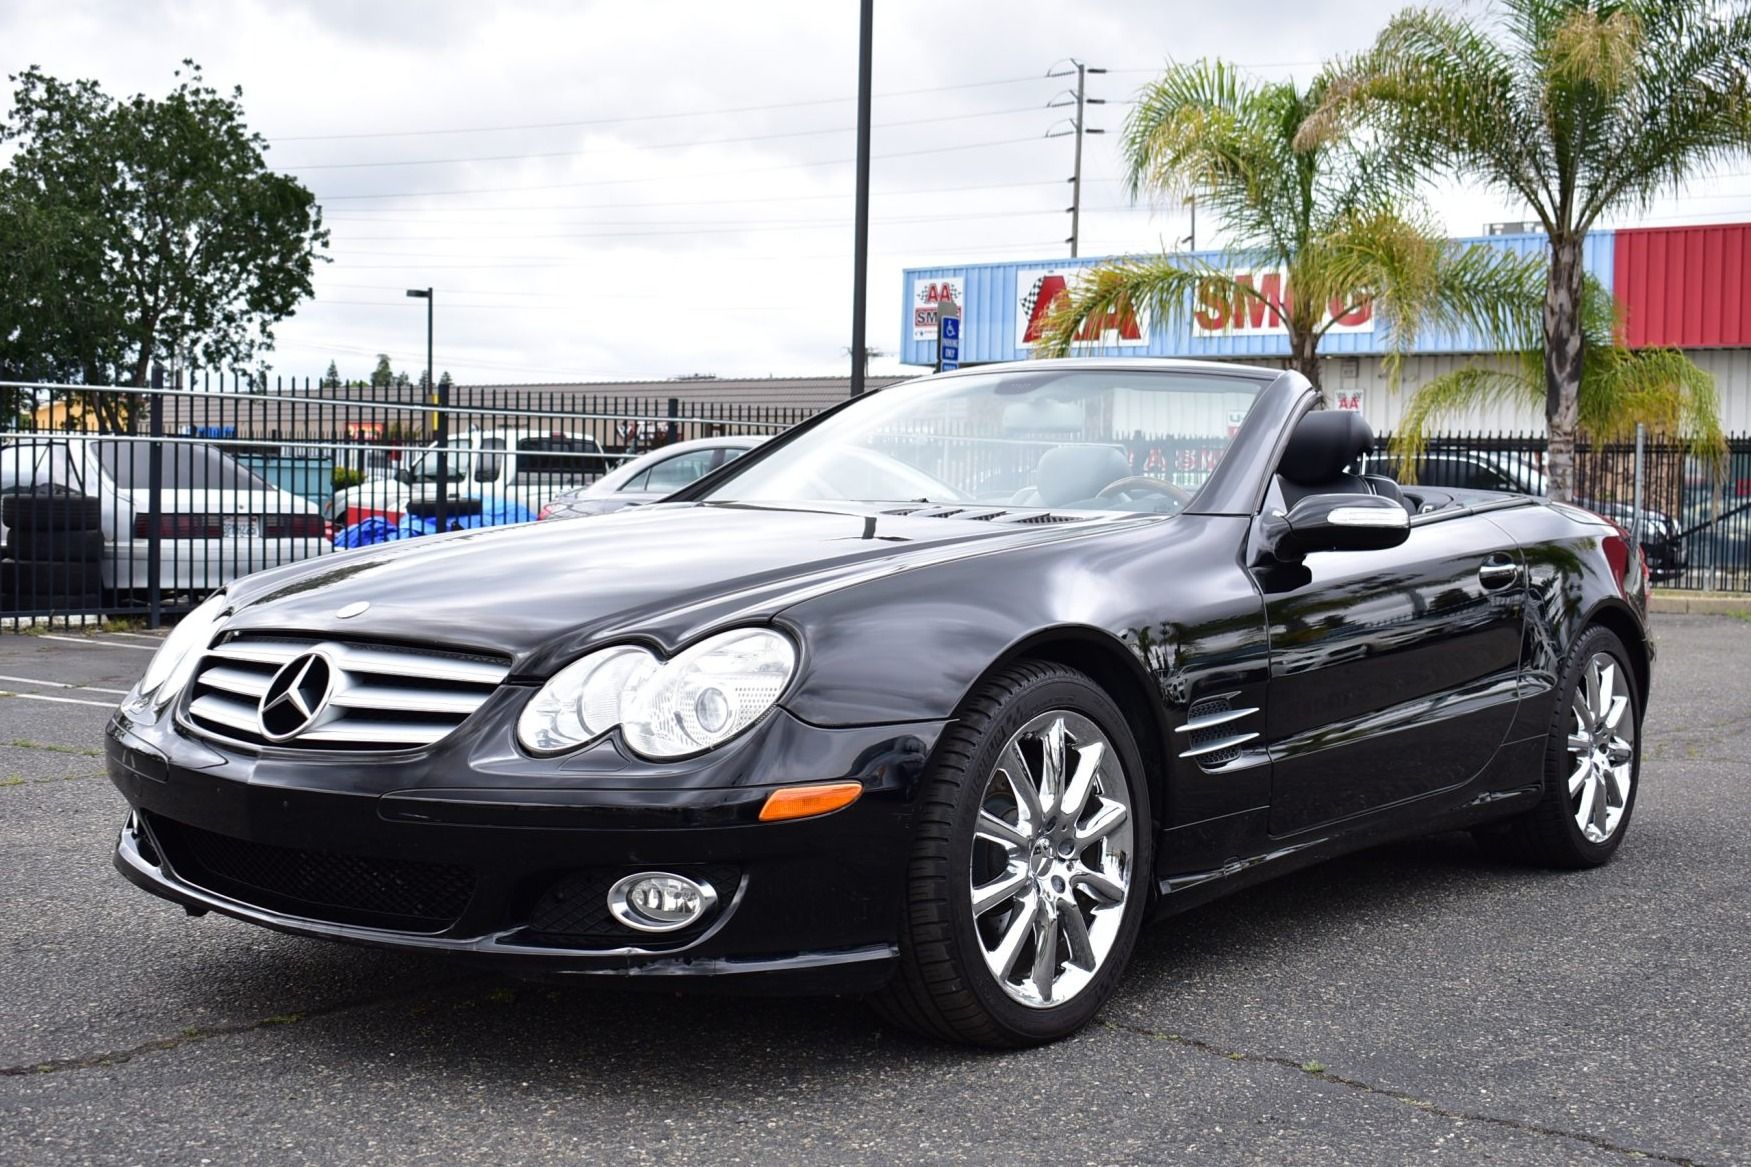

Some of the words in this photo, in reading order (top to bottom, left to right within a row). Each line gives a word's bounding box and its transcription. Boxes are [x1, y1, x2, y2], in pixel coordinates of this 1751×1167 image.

[927, 282, 953, 302] AA
[1022, 275, 1141, 343] AA
[1194, 273, 1373, 331] SMG
